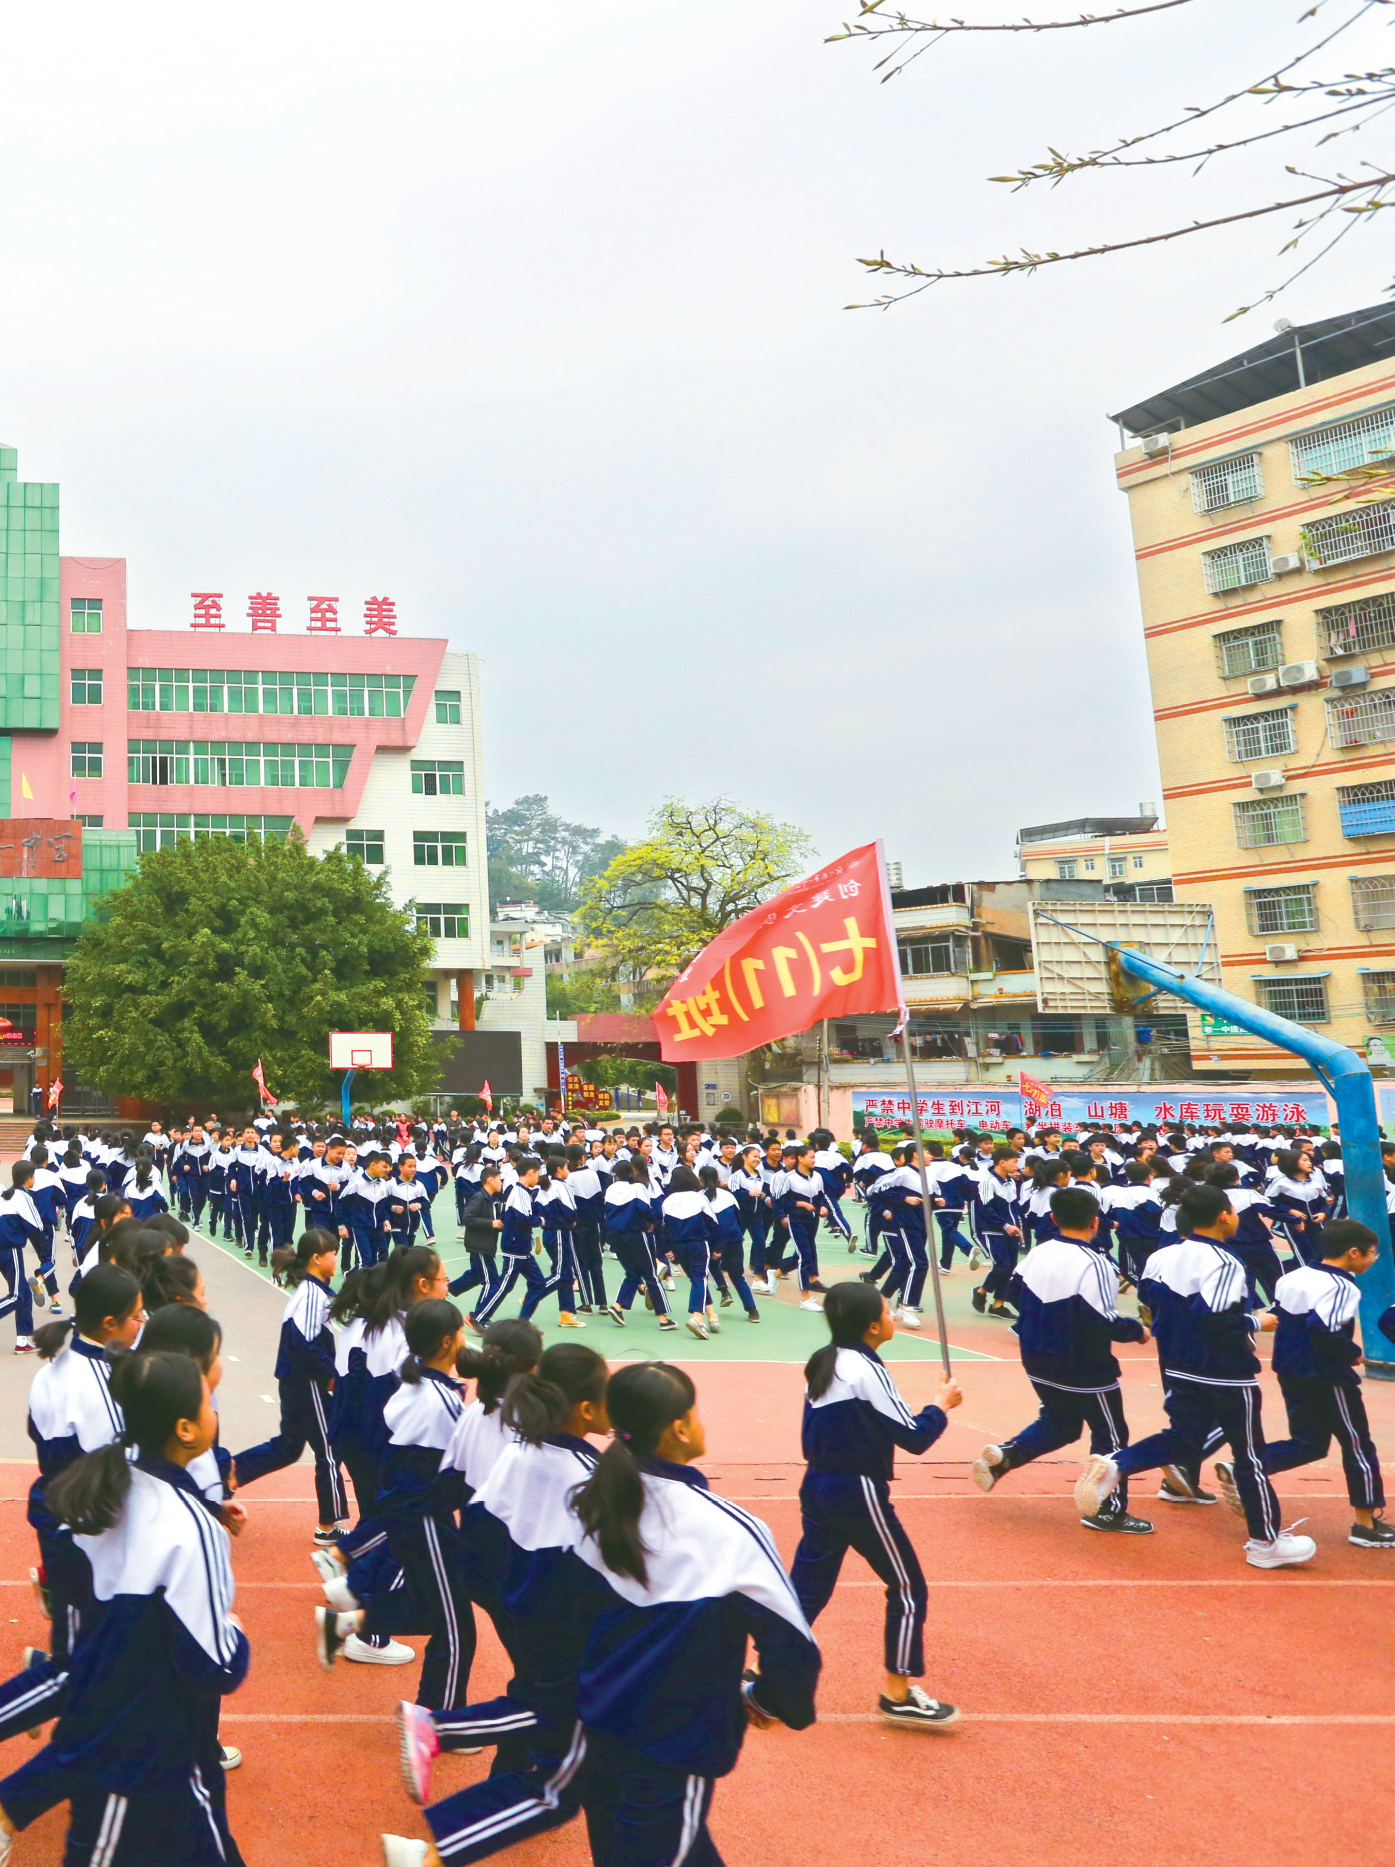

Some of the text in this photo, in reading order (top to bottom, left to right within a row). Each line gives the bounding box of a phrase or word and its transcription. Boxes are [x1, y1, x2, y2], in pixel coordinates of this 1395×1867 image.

[190, 591, 398, 636] 至善至美
[864, 1099, 1002, 1116] 严禁中学生到江河
[1087, 1101, 1129, 1120] 山塘
[1154, 1101, 1308, 1123] 水库玩耍游泳
